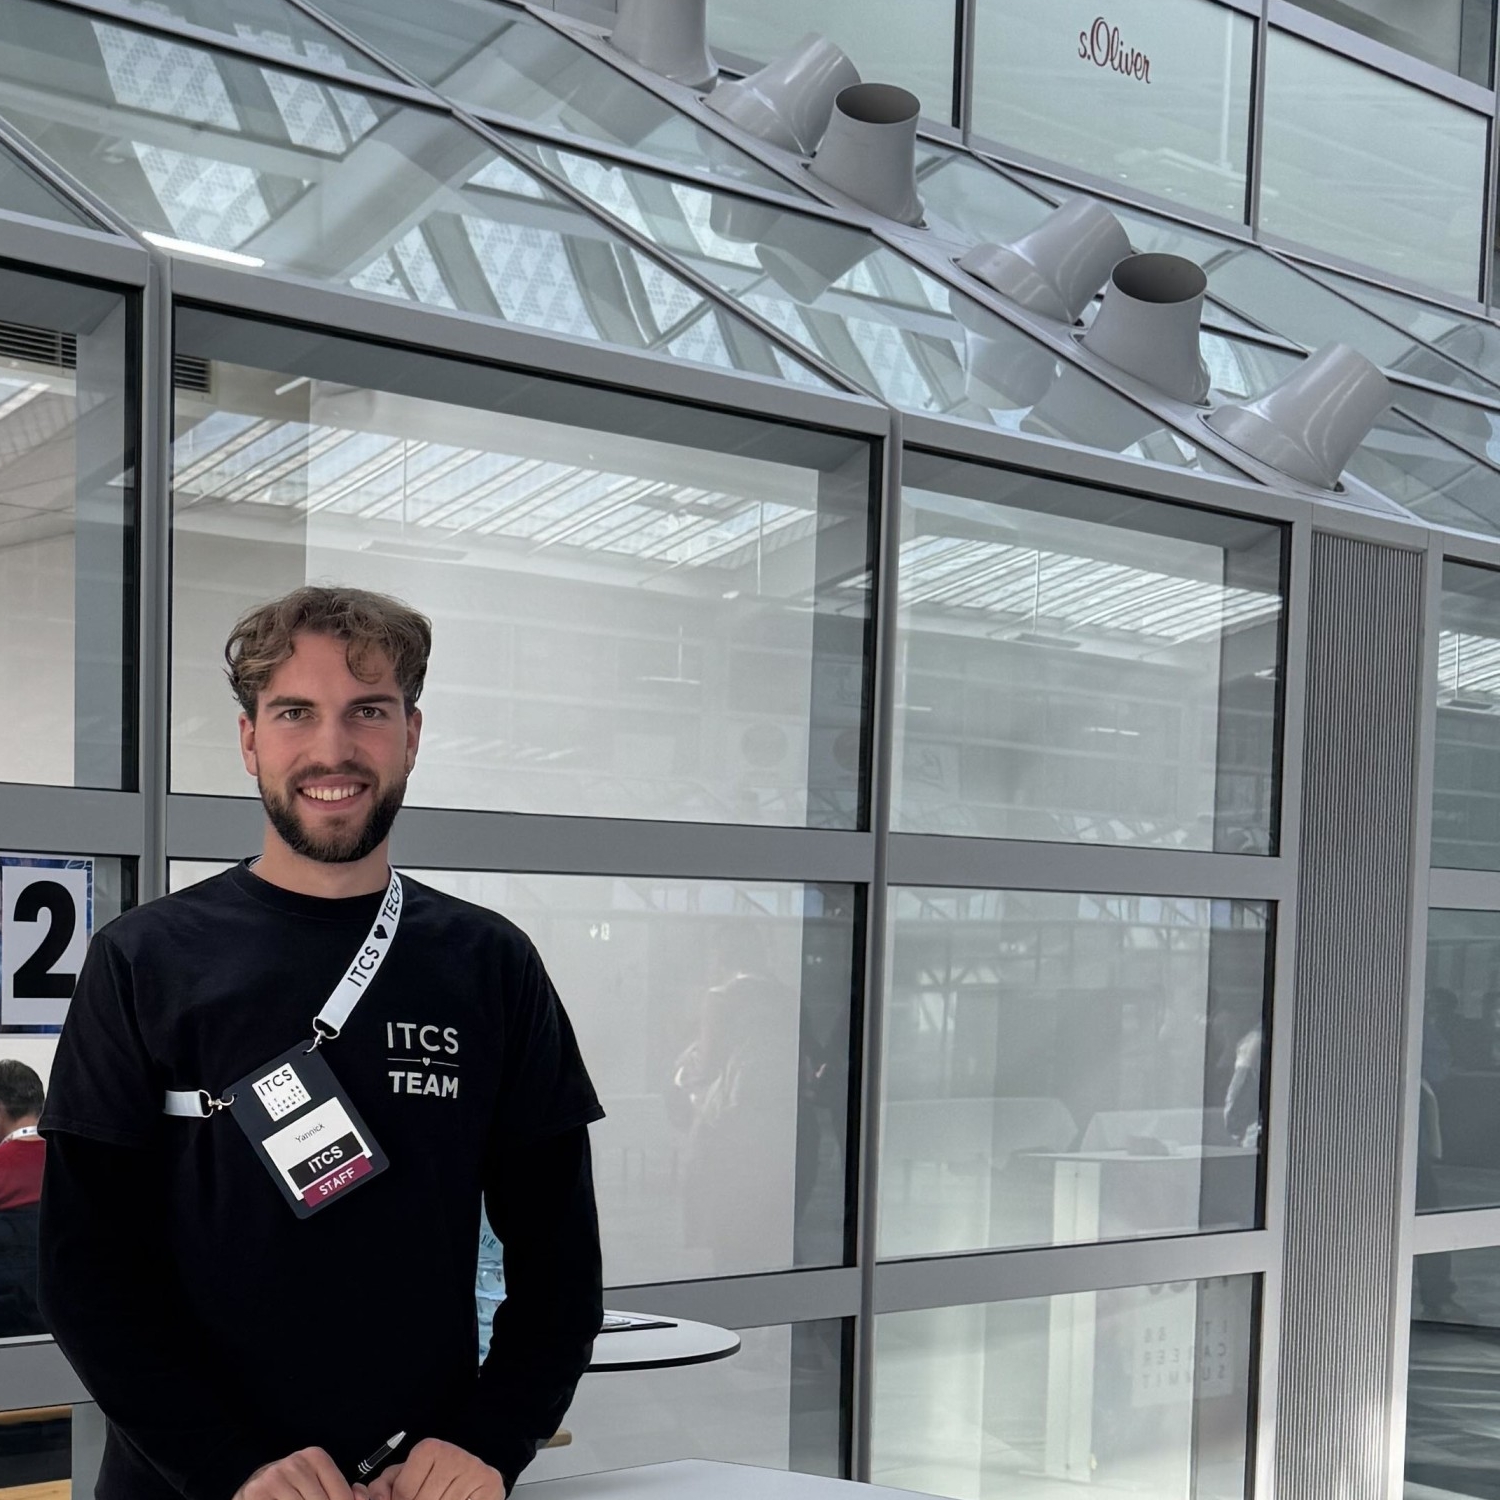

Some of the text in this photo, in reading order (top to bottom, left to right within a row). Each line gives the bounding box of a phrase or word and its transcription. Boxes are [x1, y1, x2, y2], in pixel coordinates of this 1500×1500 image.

[1078, 16, 1151, 84] s.Oliver
[13, 880, 77, 999] 2
[347, 946, 380, 988] ITCS
[387, 1022, 459, 1055] ITCS
[258, 1069, 292, 1096] ITCS
[388, 1071, 459, 1099] TEAM
[308, 1145, 343, 1174] ITCS
[319, 1167, 355, 1196] STAFF
